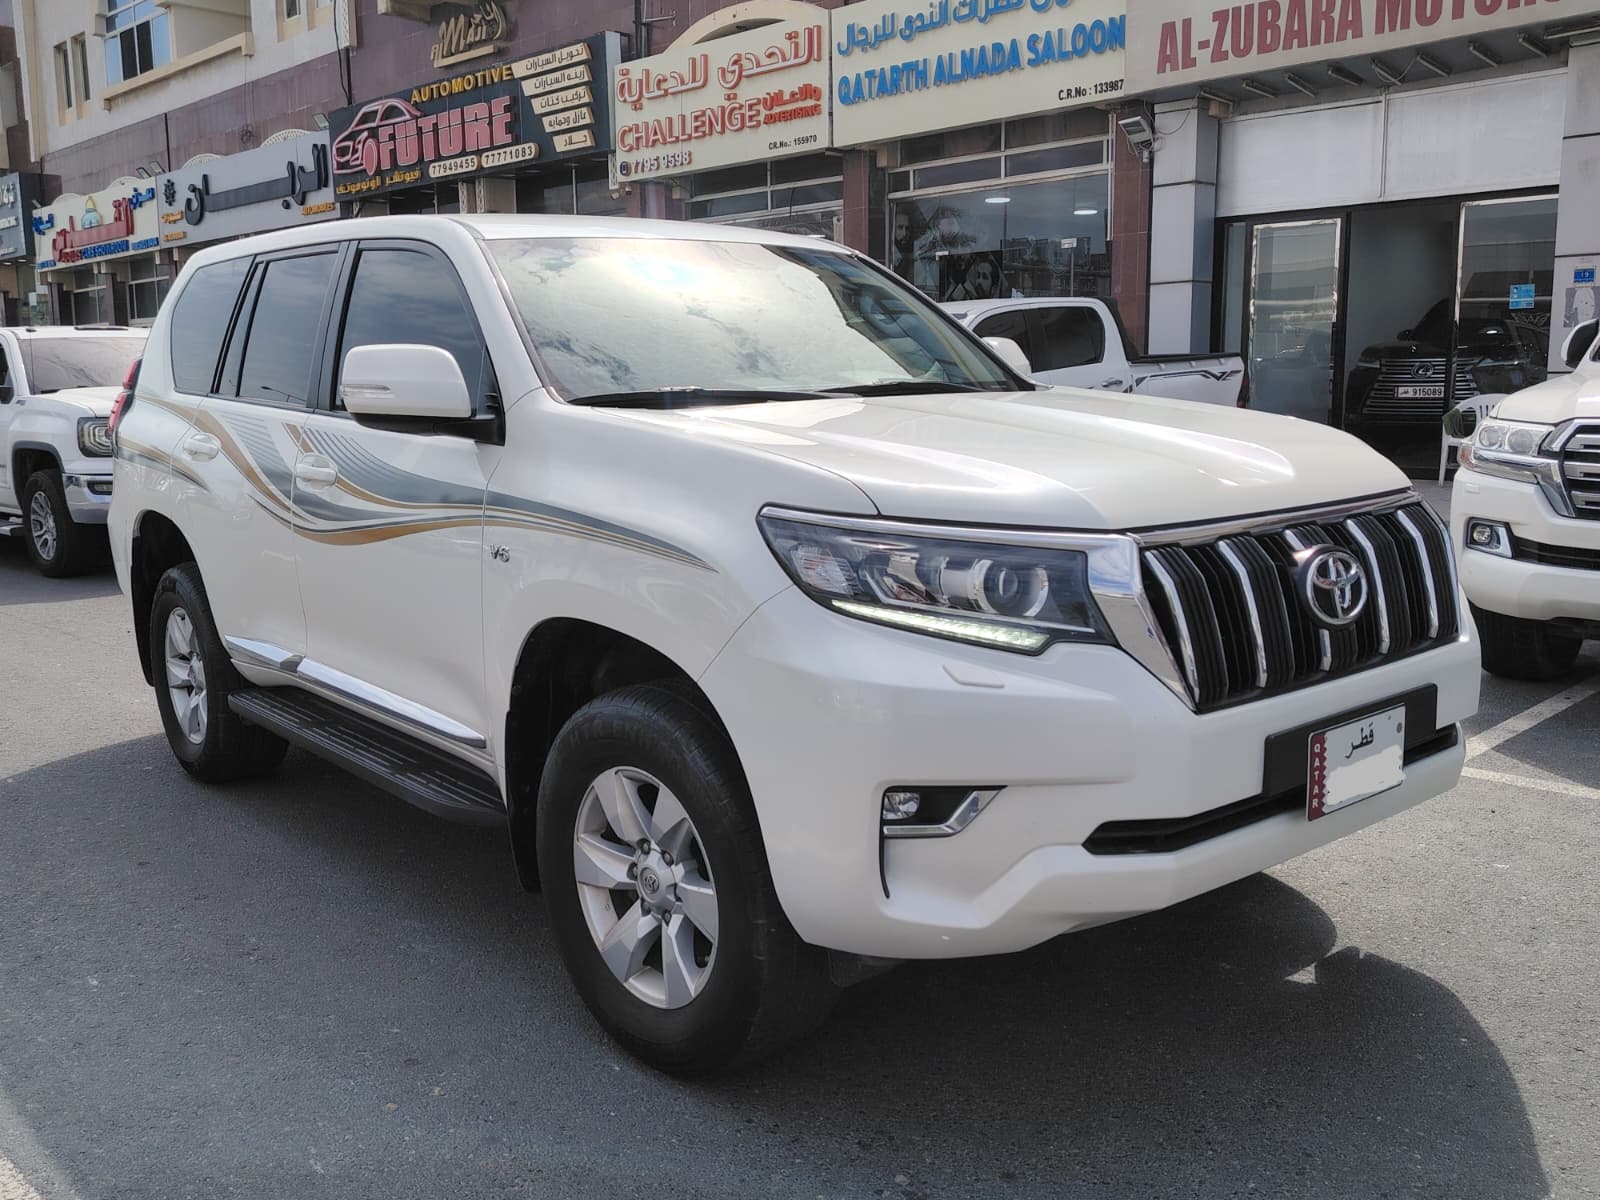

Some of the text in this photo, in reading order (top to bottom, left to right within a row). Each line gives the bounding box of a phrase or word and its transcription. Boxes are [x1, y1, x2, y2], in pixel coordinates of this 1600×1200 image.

[837, 12, 896, 56] للرجال
[1156, 0, 1364, 74] AL-ZUBARA
[525, 53, 557, 71] السيارات
[616, 24, 822, 111] التحدي للدعاية
[837, 14, 1127, 106] QATARTH ALNADA SALOON
[410, 64, 513, 105] AUTOMOTIVE
[534, 72, 566, 90] السيارات
[1093, 79, 1125, 95] 133987
[378, 95, 513, 171] FUTURE
[617, 97, 762, 153] CHALLENGE
[763, 103, 822, 125] ADVERTISING
[484, 145, 533, 165] 77771083
[793, 134, 818, 146] 155970
[431, 157, 477, 175] 77949455
[1411, 387, 1442, 397] 915089
[1344, 721, 1375, 759] قطر
[1312, 743, 1321, 809] QATAR
